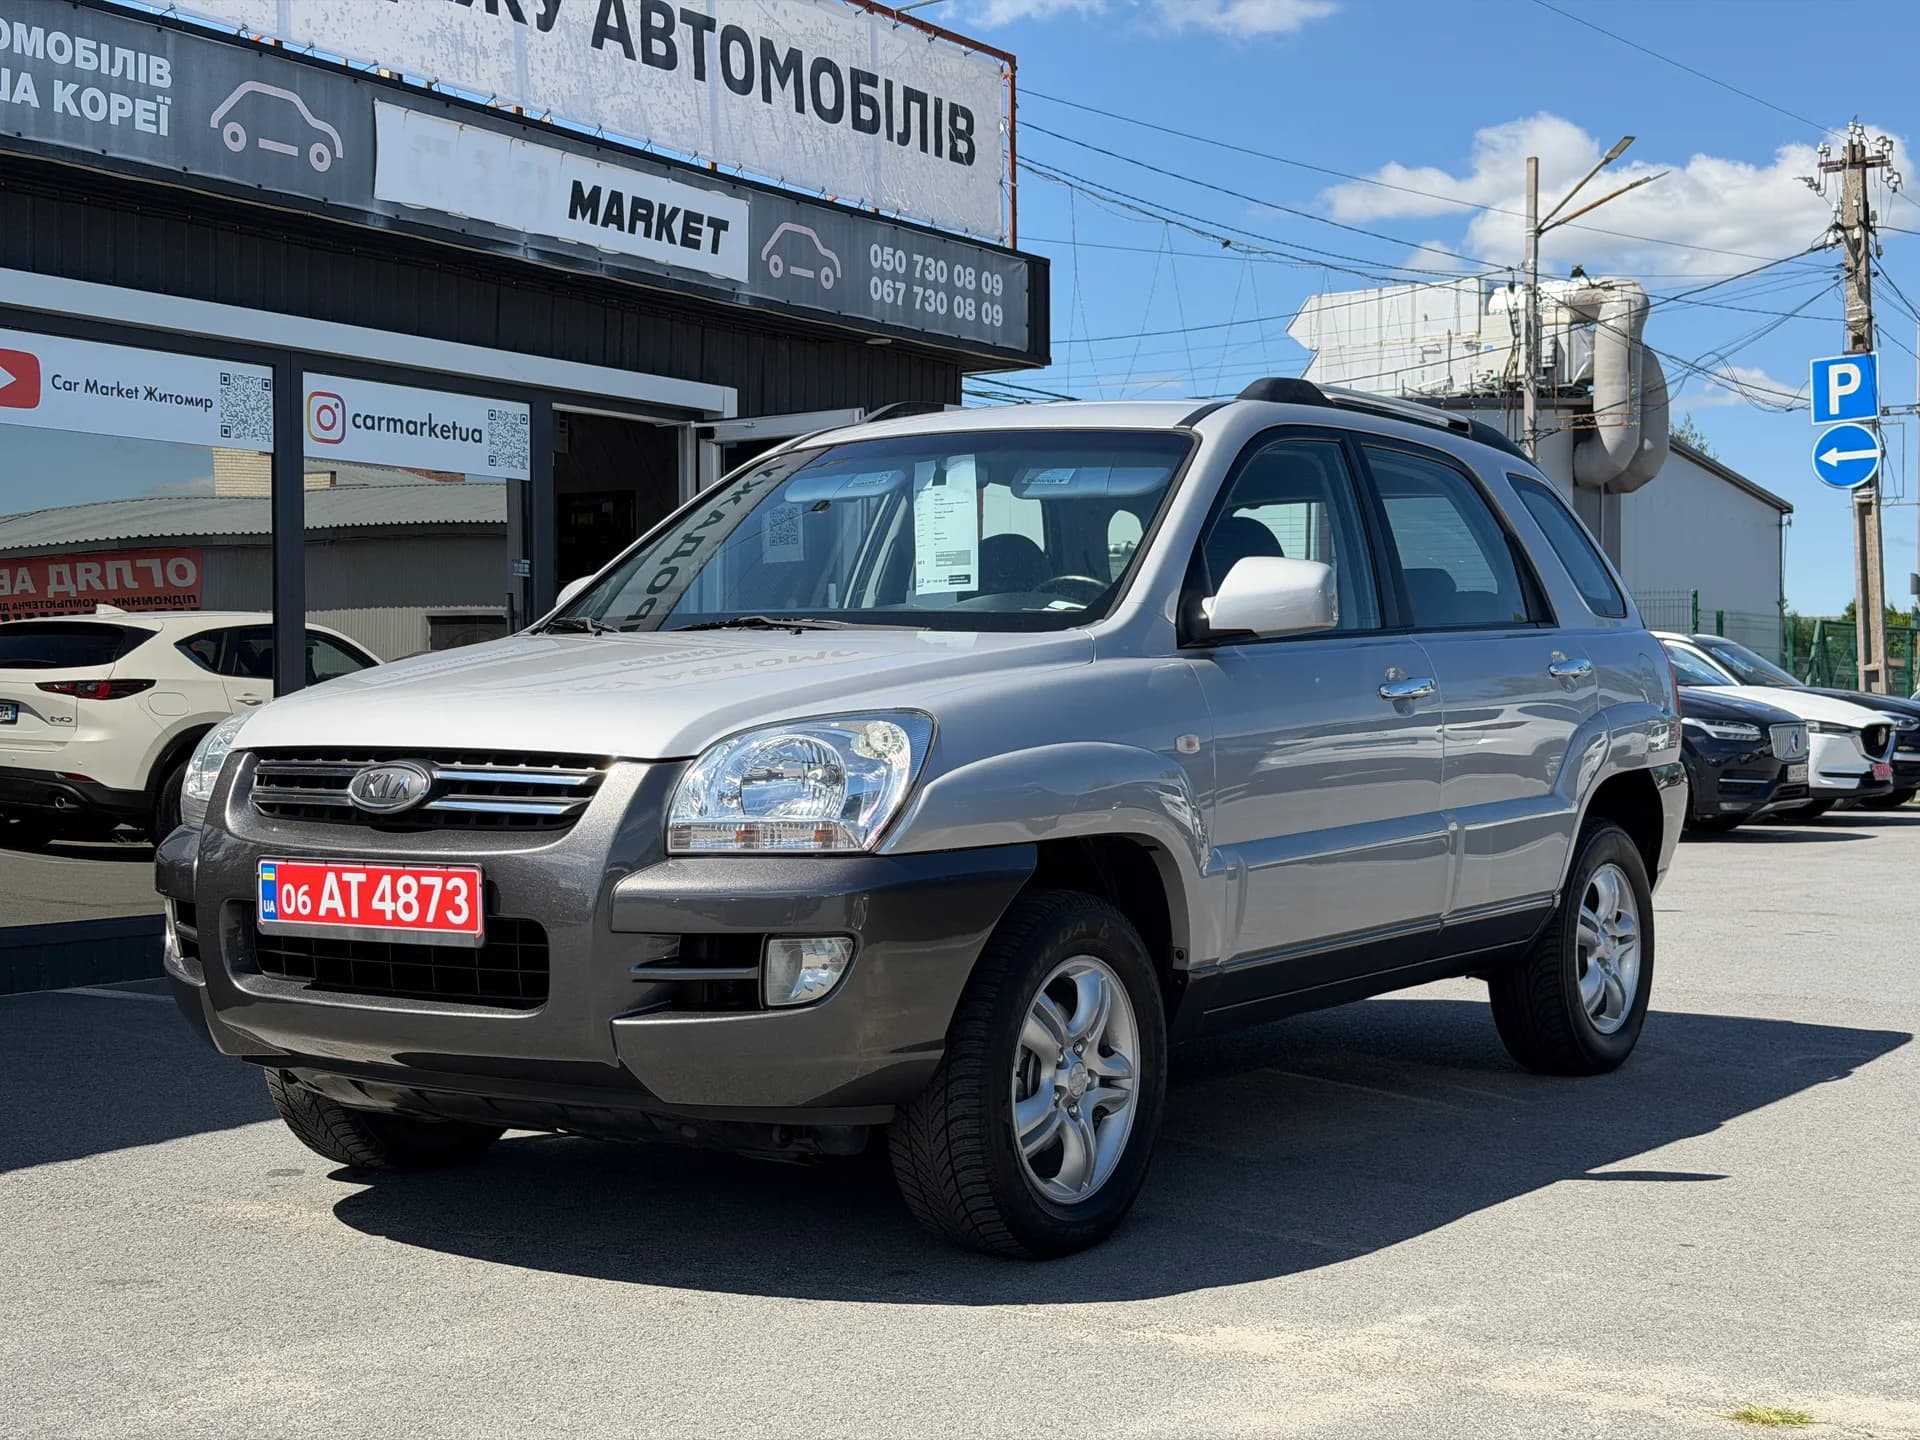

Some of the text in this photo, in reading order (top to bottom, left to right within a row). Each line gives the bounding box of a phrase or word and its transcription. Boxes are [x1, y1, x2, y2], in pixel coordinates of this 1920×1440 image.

[53, 79, 172, 137] КОРЕЇ
[590, 0, 976, 167] АВТОМОБІЛІВ
[568, 179, 729, 255] MARKET
[870, 243, 1003, 297] 050 730 08 09
[870, 276, 1003, 328] 067 730 08 09
[51, 374, 214, 412] Car Market Житомир
[1829, 364, 1861, 415] P
[352, 412, 483, 444] carmarketua
[360, 773, 410, 800] KIA
[263, 900, 276, 913] UA
[281, 871, 470, 925] 06 AT 4873
